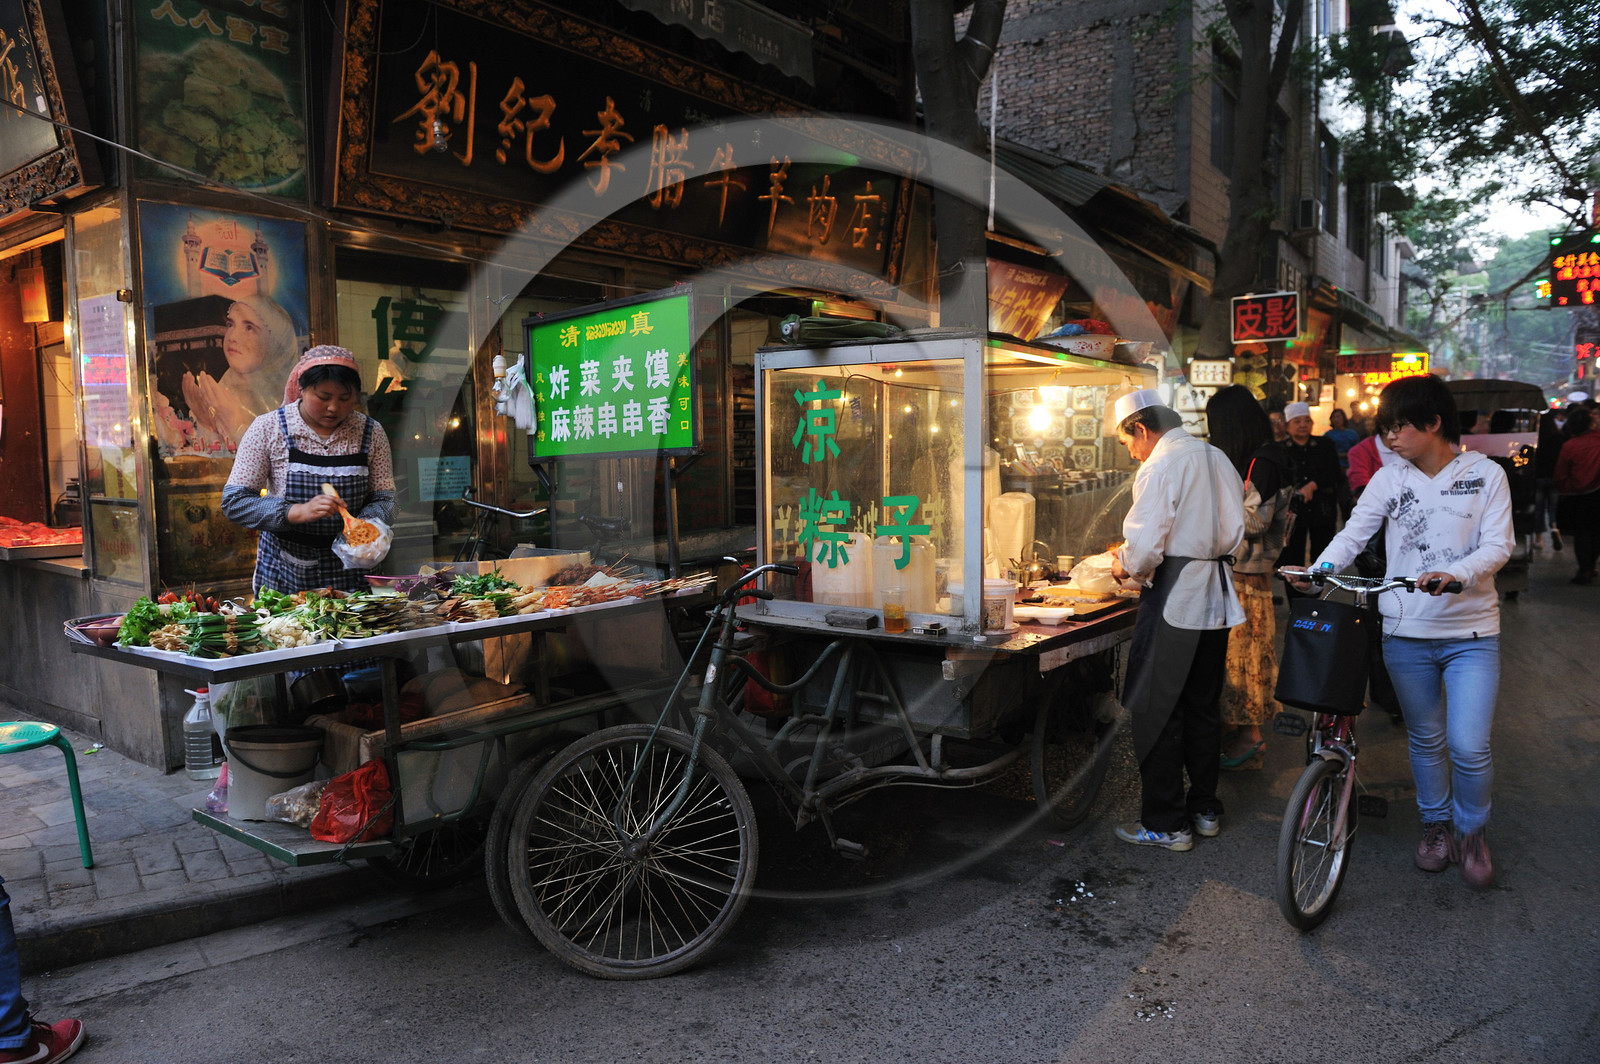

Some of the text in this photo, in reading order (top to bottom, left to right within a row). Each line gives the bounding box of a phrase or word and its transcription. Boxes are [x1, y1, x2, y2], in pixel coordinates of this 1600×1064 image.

[559, 325, 580, 347] 清
[629, 310, 654, 337] 真
[1234, 296, 1297, 339] 皮影
[549, 348, 670, 400] 炸菜夹馍
[676, 352, 690, 431] 美味可口
[550, 396, 671, 443] 麻辣串串香
[792, 379, 841, 464] 凉
[798, 487, 930, 570] 粽子
[1293, 619, 1332, 632] DAHON
